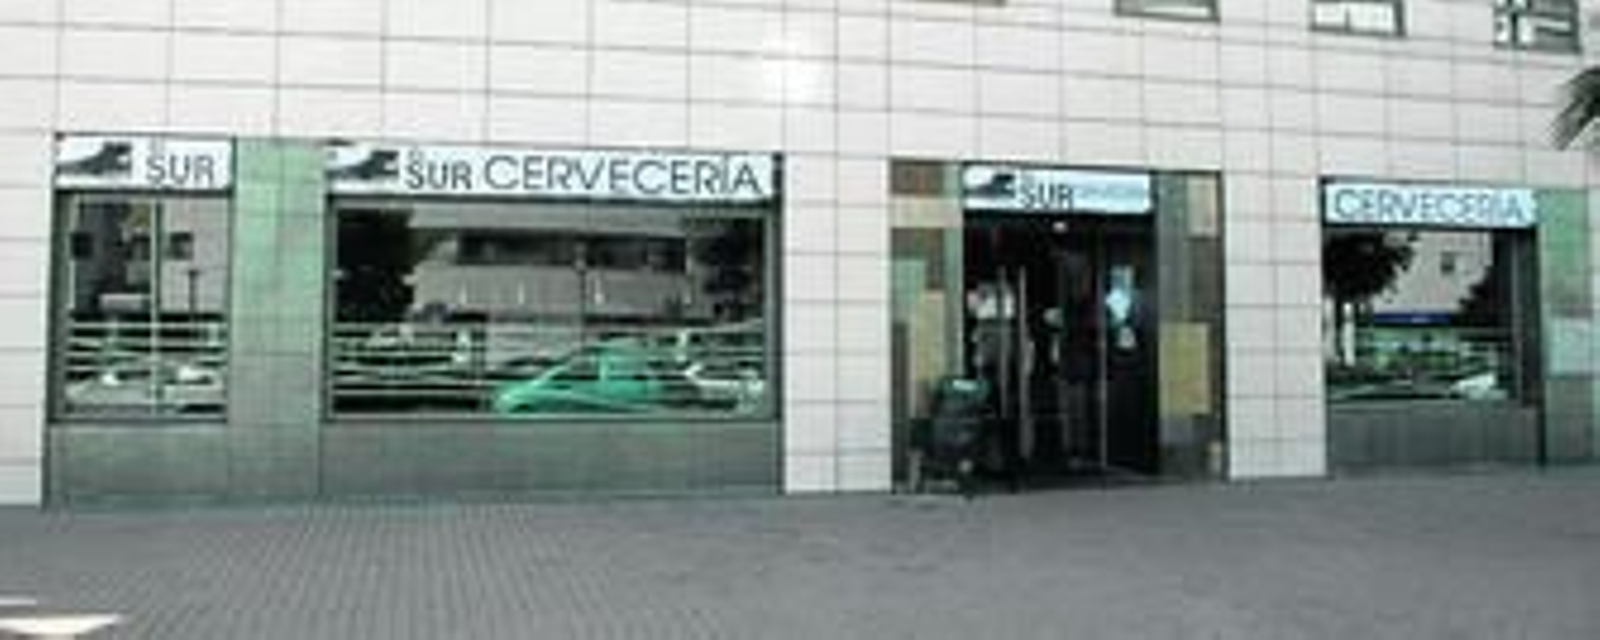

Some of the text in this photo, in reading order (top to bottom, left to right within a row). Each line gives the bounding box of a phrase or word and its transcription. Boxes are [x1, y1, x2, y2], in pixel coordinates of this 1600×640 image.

[146, 155, 215, 186] SUR
[405, 159, 473, 190] SUR
[1020, 182, 1074, 209] SUR
